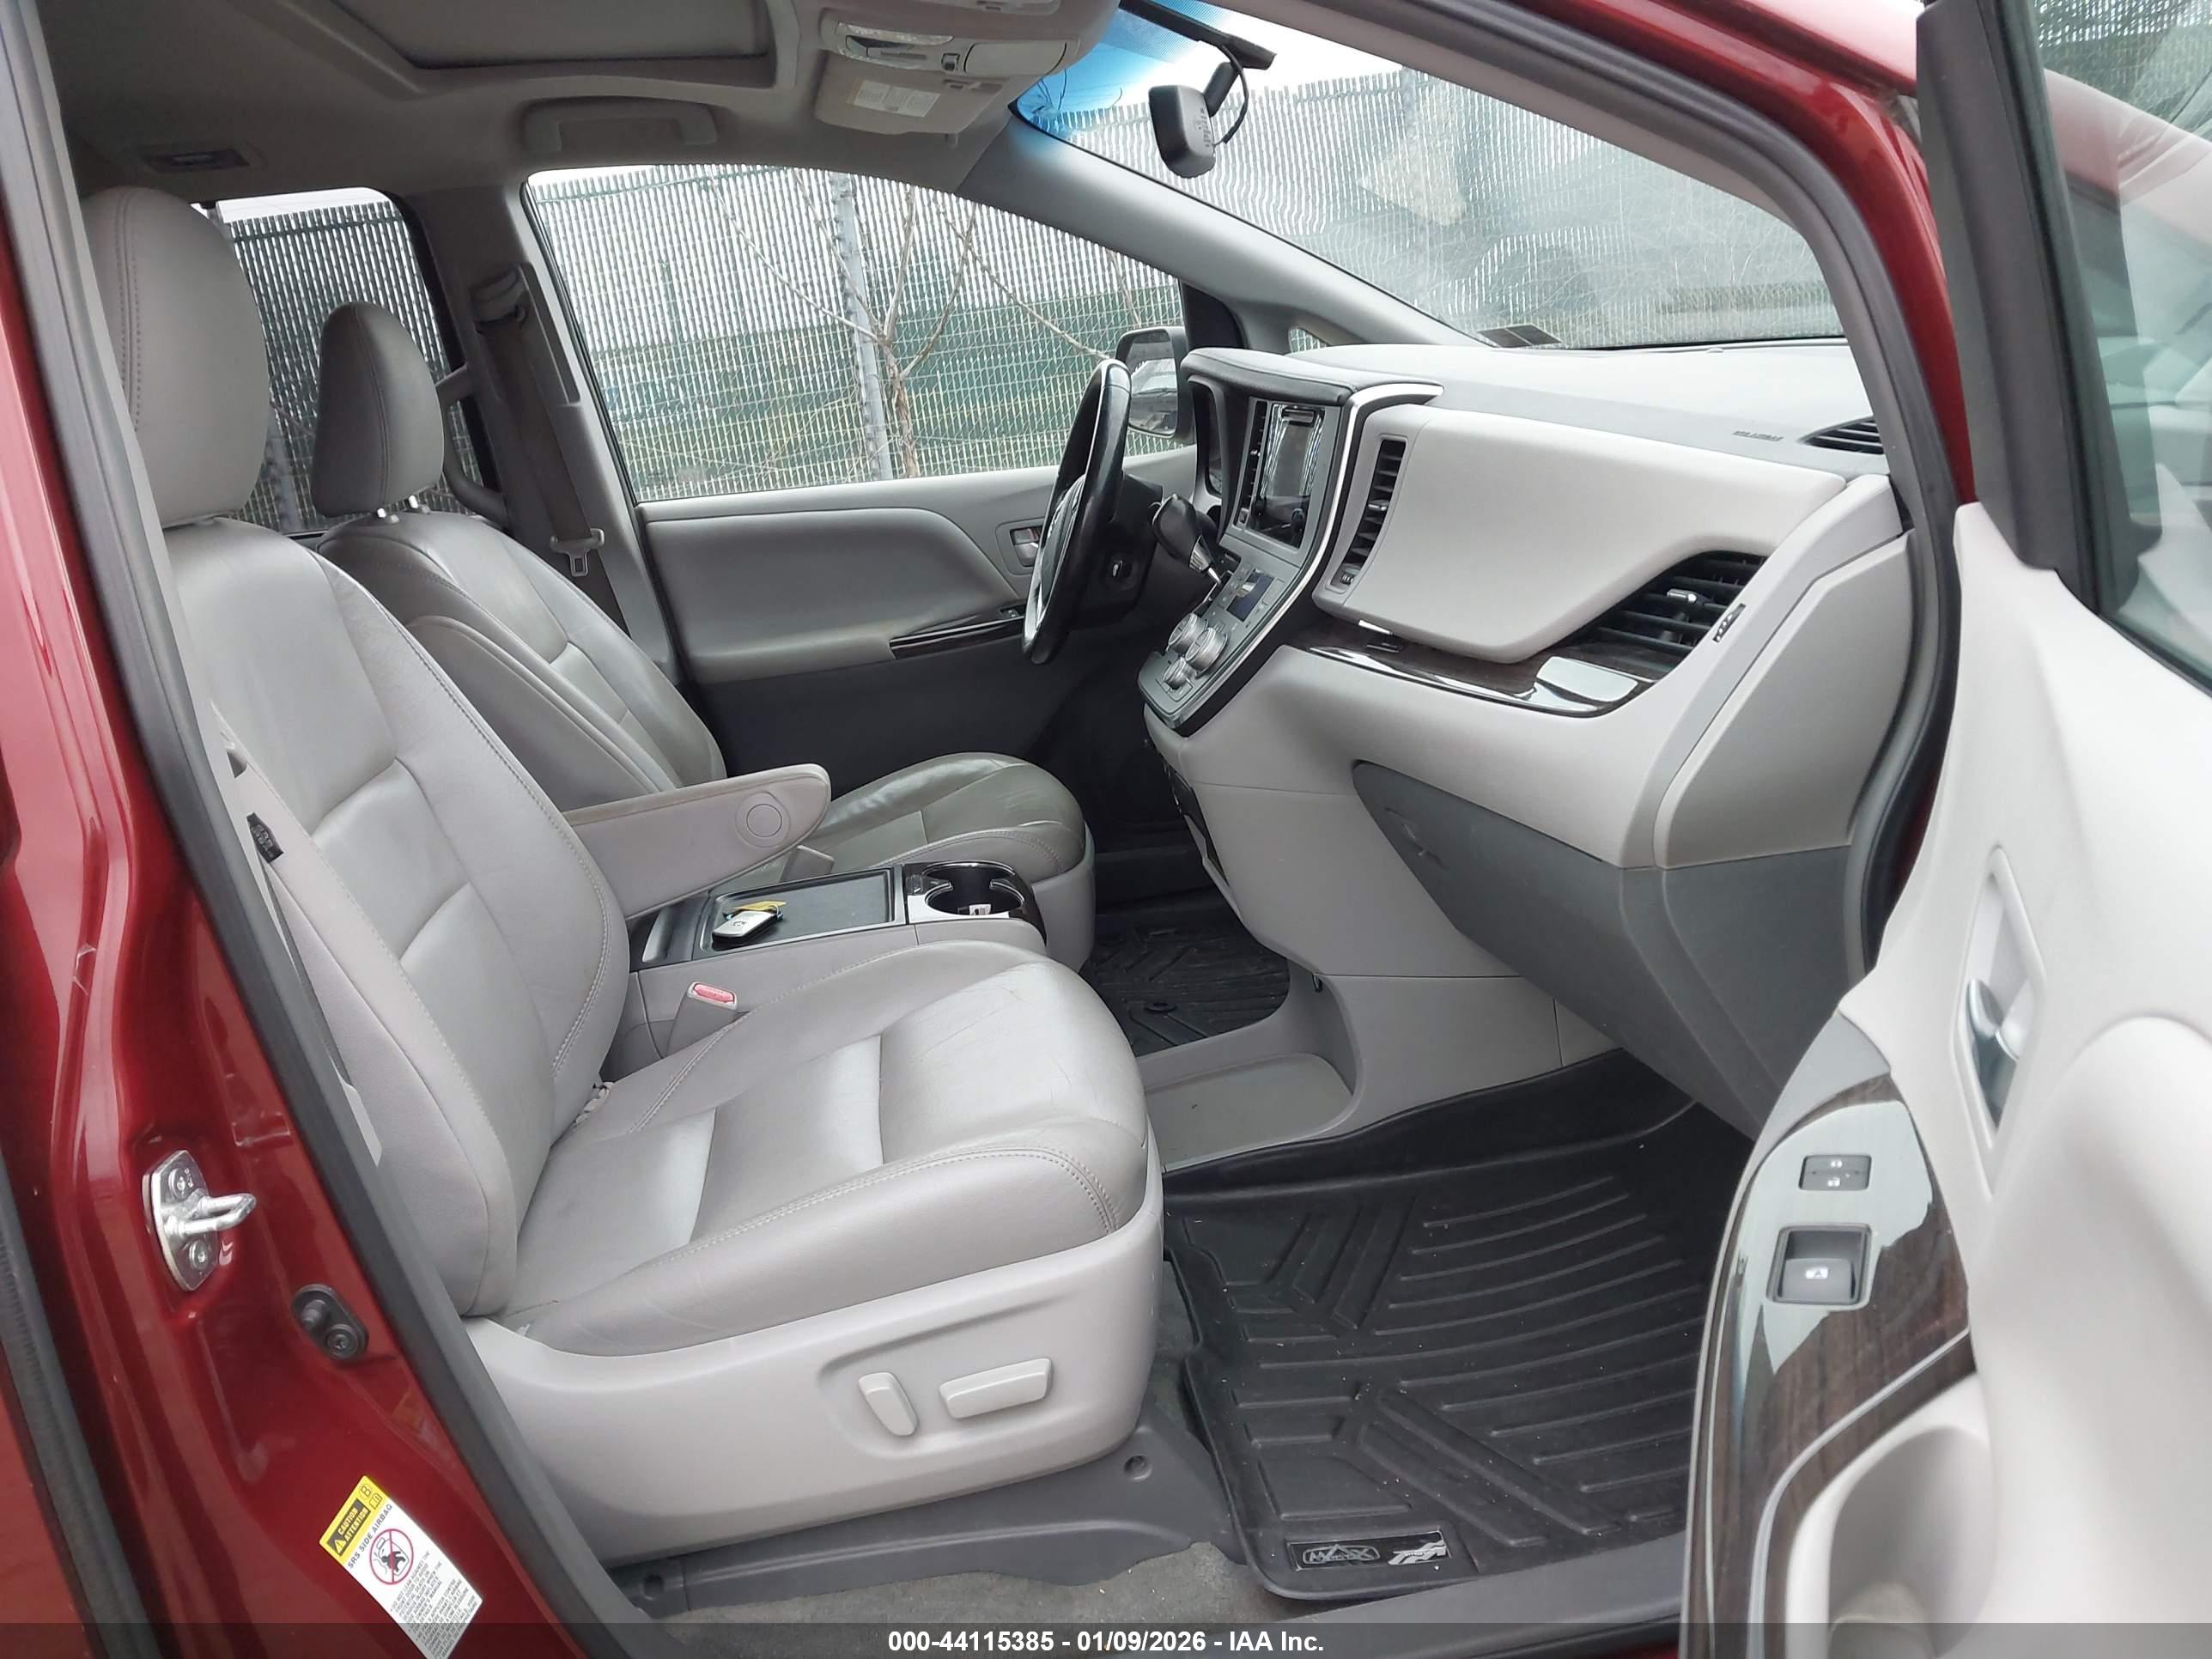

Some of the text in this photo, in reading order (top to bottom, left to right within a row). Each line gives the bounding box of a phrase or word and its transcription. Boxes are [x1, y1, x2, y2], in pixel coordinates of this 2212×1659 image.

[338, 1507, 359, 1535] CAUTION
[343, 1507, 369, 1542] ATTENTION
[347, 1504, 393, 1569] SRS SIDE AIRBAG
